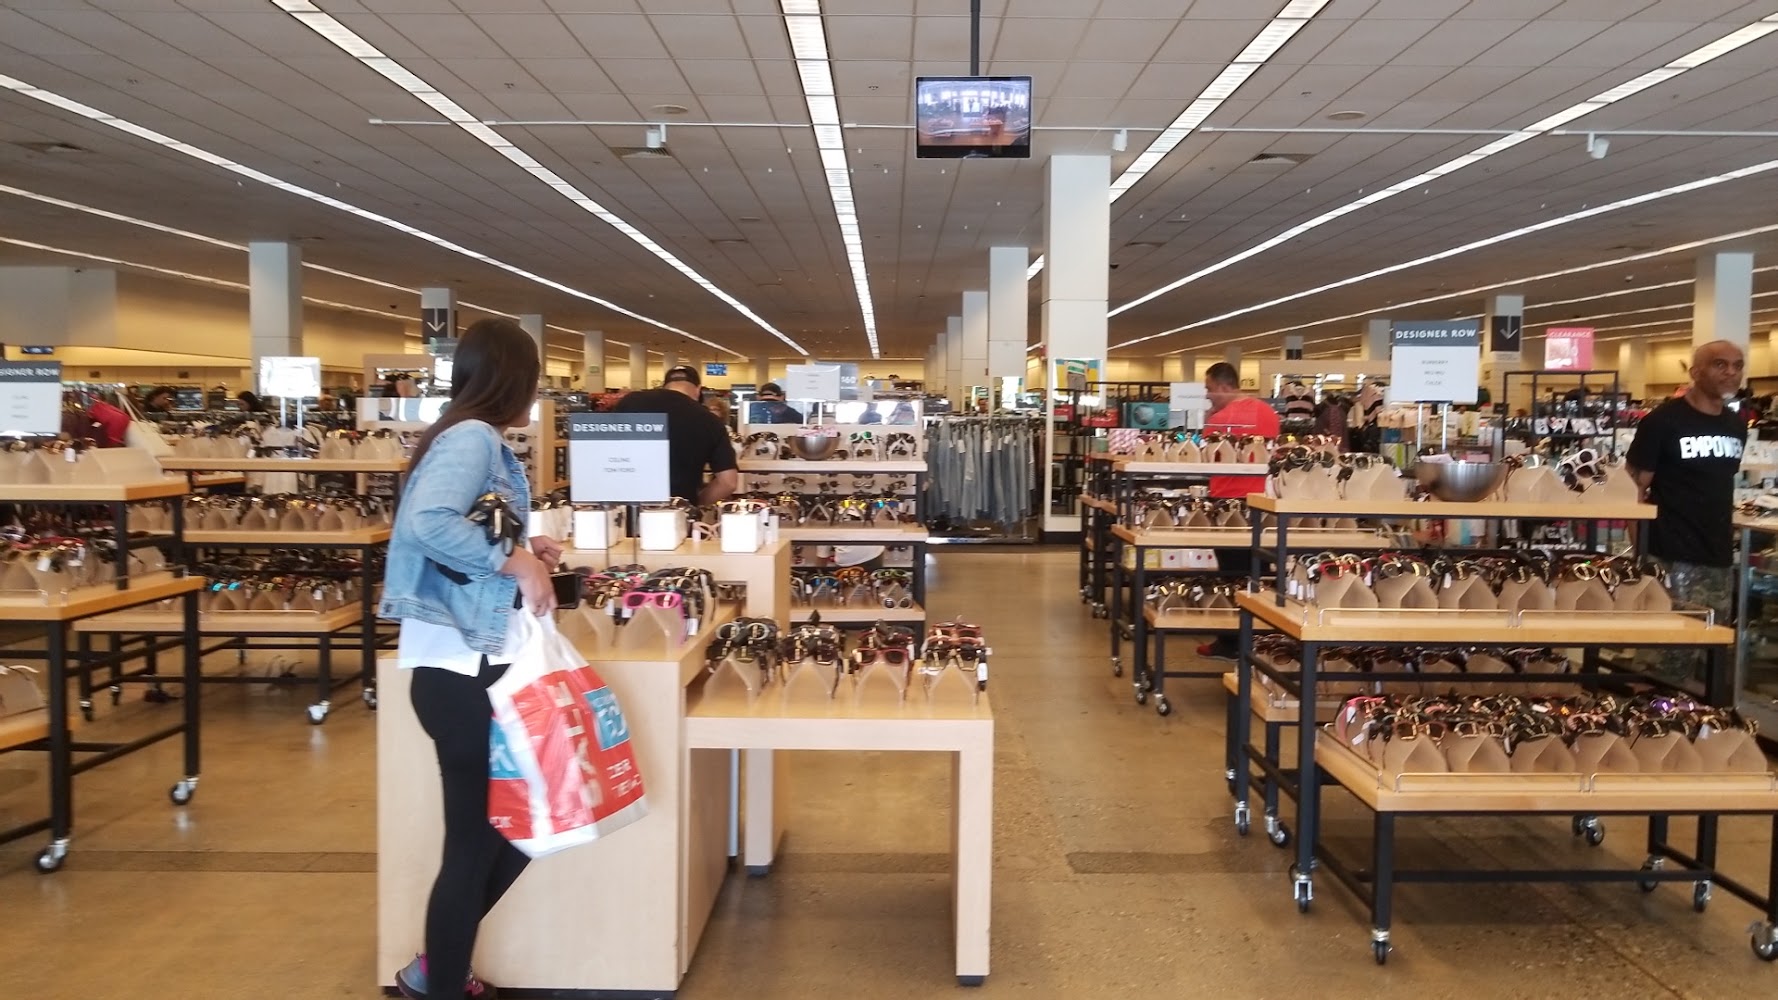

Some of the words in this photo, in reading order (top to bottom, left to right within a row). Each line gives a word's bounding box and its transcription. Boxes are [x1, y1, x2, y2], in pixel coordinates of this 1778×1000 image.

[1395, 329, 1448, 339] DESIGNER
[1451, 328, 1476, 337] ROW
[1548, 331, 1591, 339] CLEARANCE
[35, 367, 59, 377] ROW
[572, 423, 632, 433] DESIGNER
[635, 423, 664, 433] ROW
